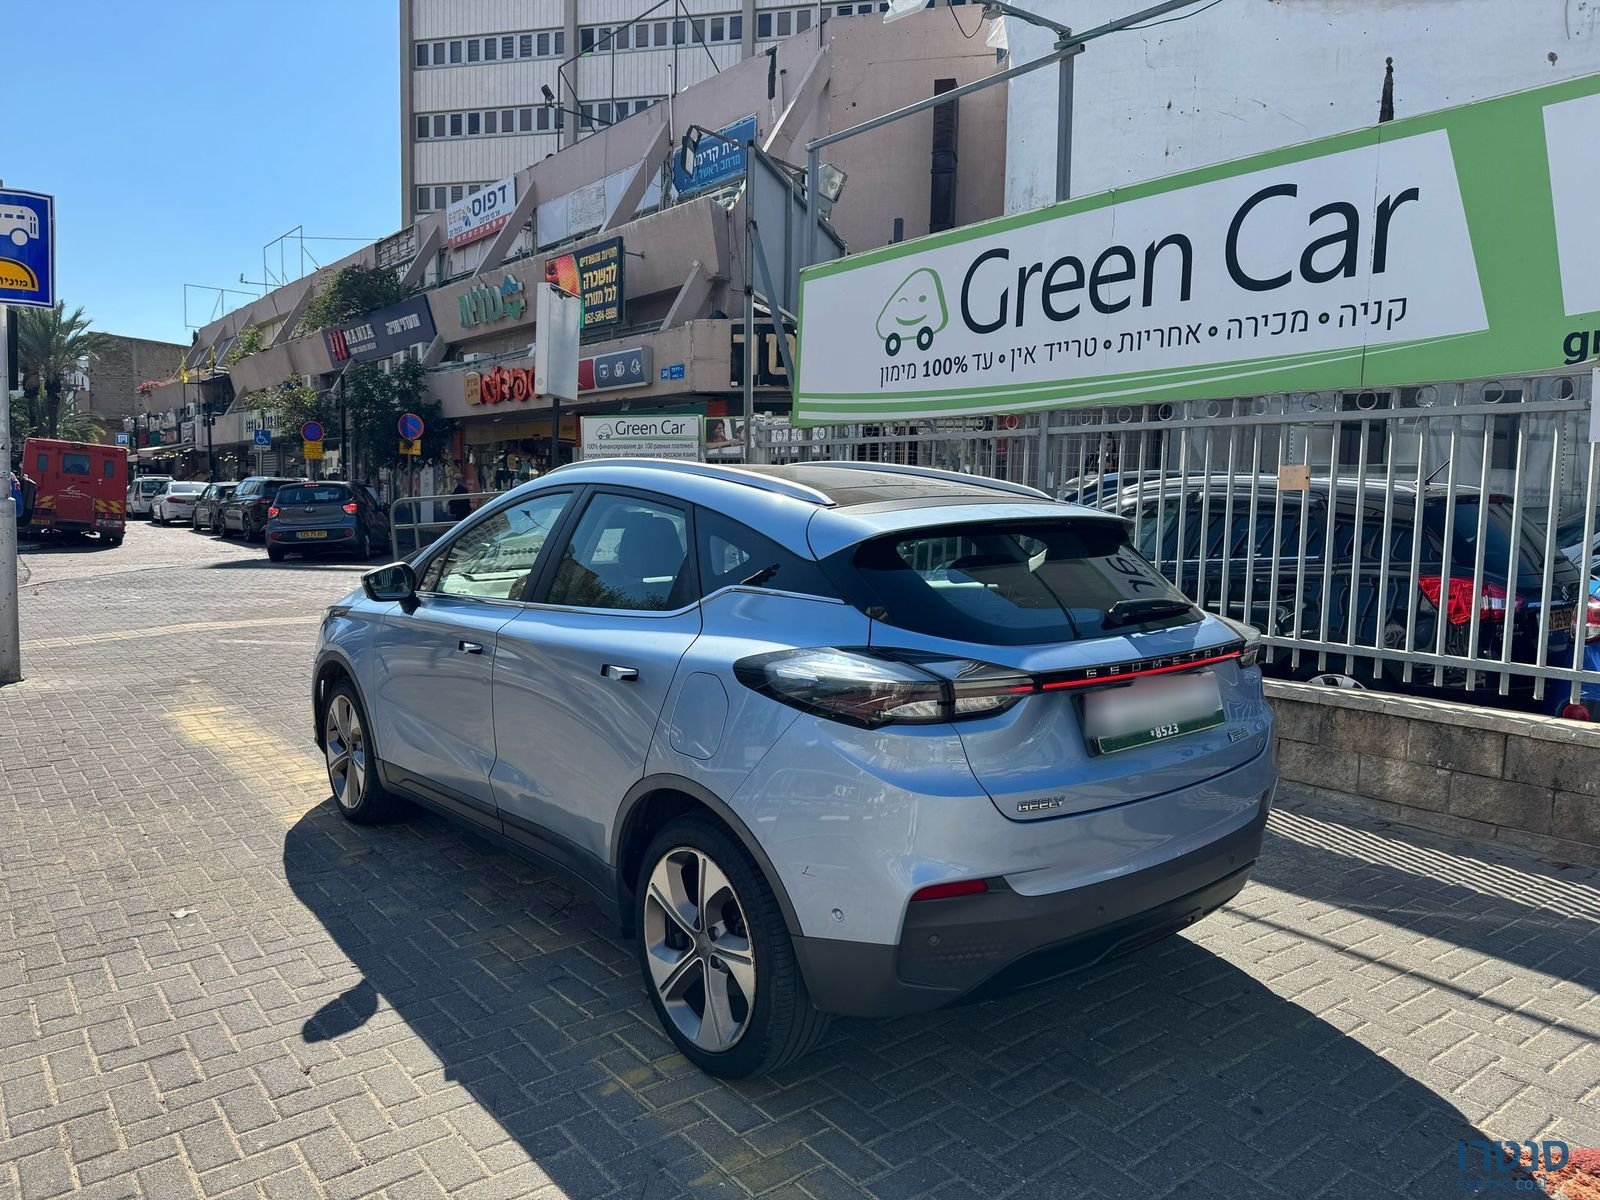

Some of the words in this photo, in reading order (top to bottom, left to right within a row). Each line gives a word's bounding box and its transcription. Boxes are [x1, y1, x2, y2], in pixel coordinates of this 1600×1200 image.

[472, 184, 506, 216] דפוס
[960, 233, 1193, 335] Green
[1225, 183, 1419, 292] Car
[583, 262, 618, 290] להשכרה
[584, 290, 604, 308] מטרה
[604, 284, 618, 304] לכל
[1226, 310, 1309, 340] מכירה
[1338, 298, 1408, 330] קניה
[343, 323, 376, 346] MANIA
[1118, 322, 1202, 353] אחריות
[972, 352, 994, 371] עד
[1010, 345, 1037, 372] אין
[1044, 337, 1098, 362] טרייד
[880, 363, 917, 388] מימון
[922, 356, 969, 378] 100%
[615, 420, 658, 436] Green
[661, 420, 686, 434] Car
[600, 442, 636, 450] финансирование
[1086, 647, 1225, 678] GEOMETRY
[1017, 795, 1065, 812] GEELY
